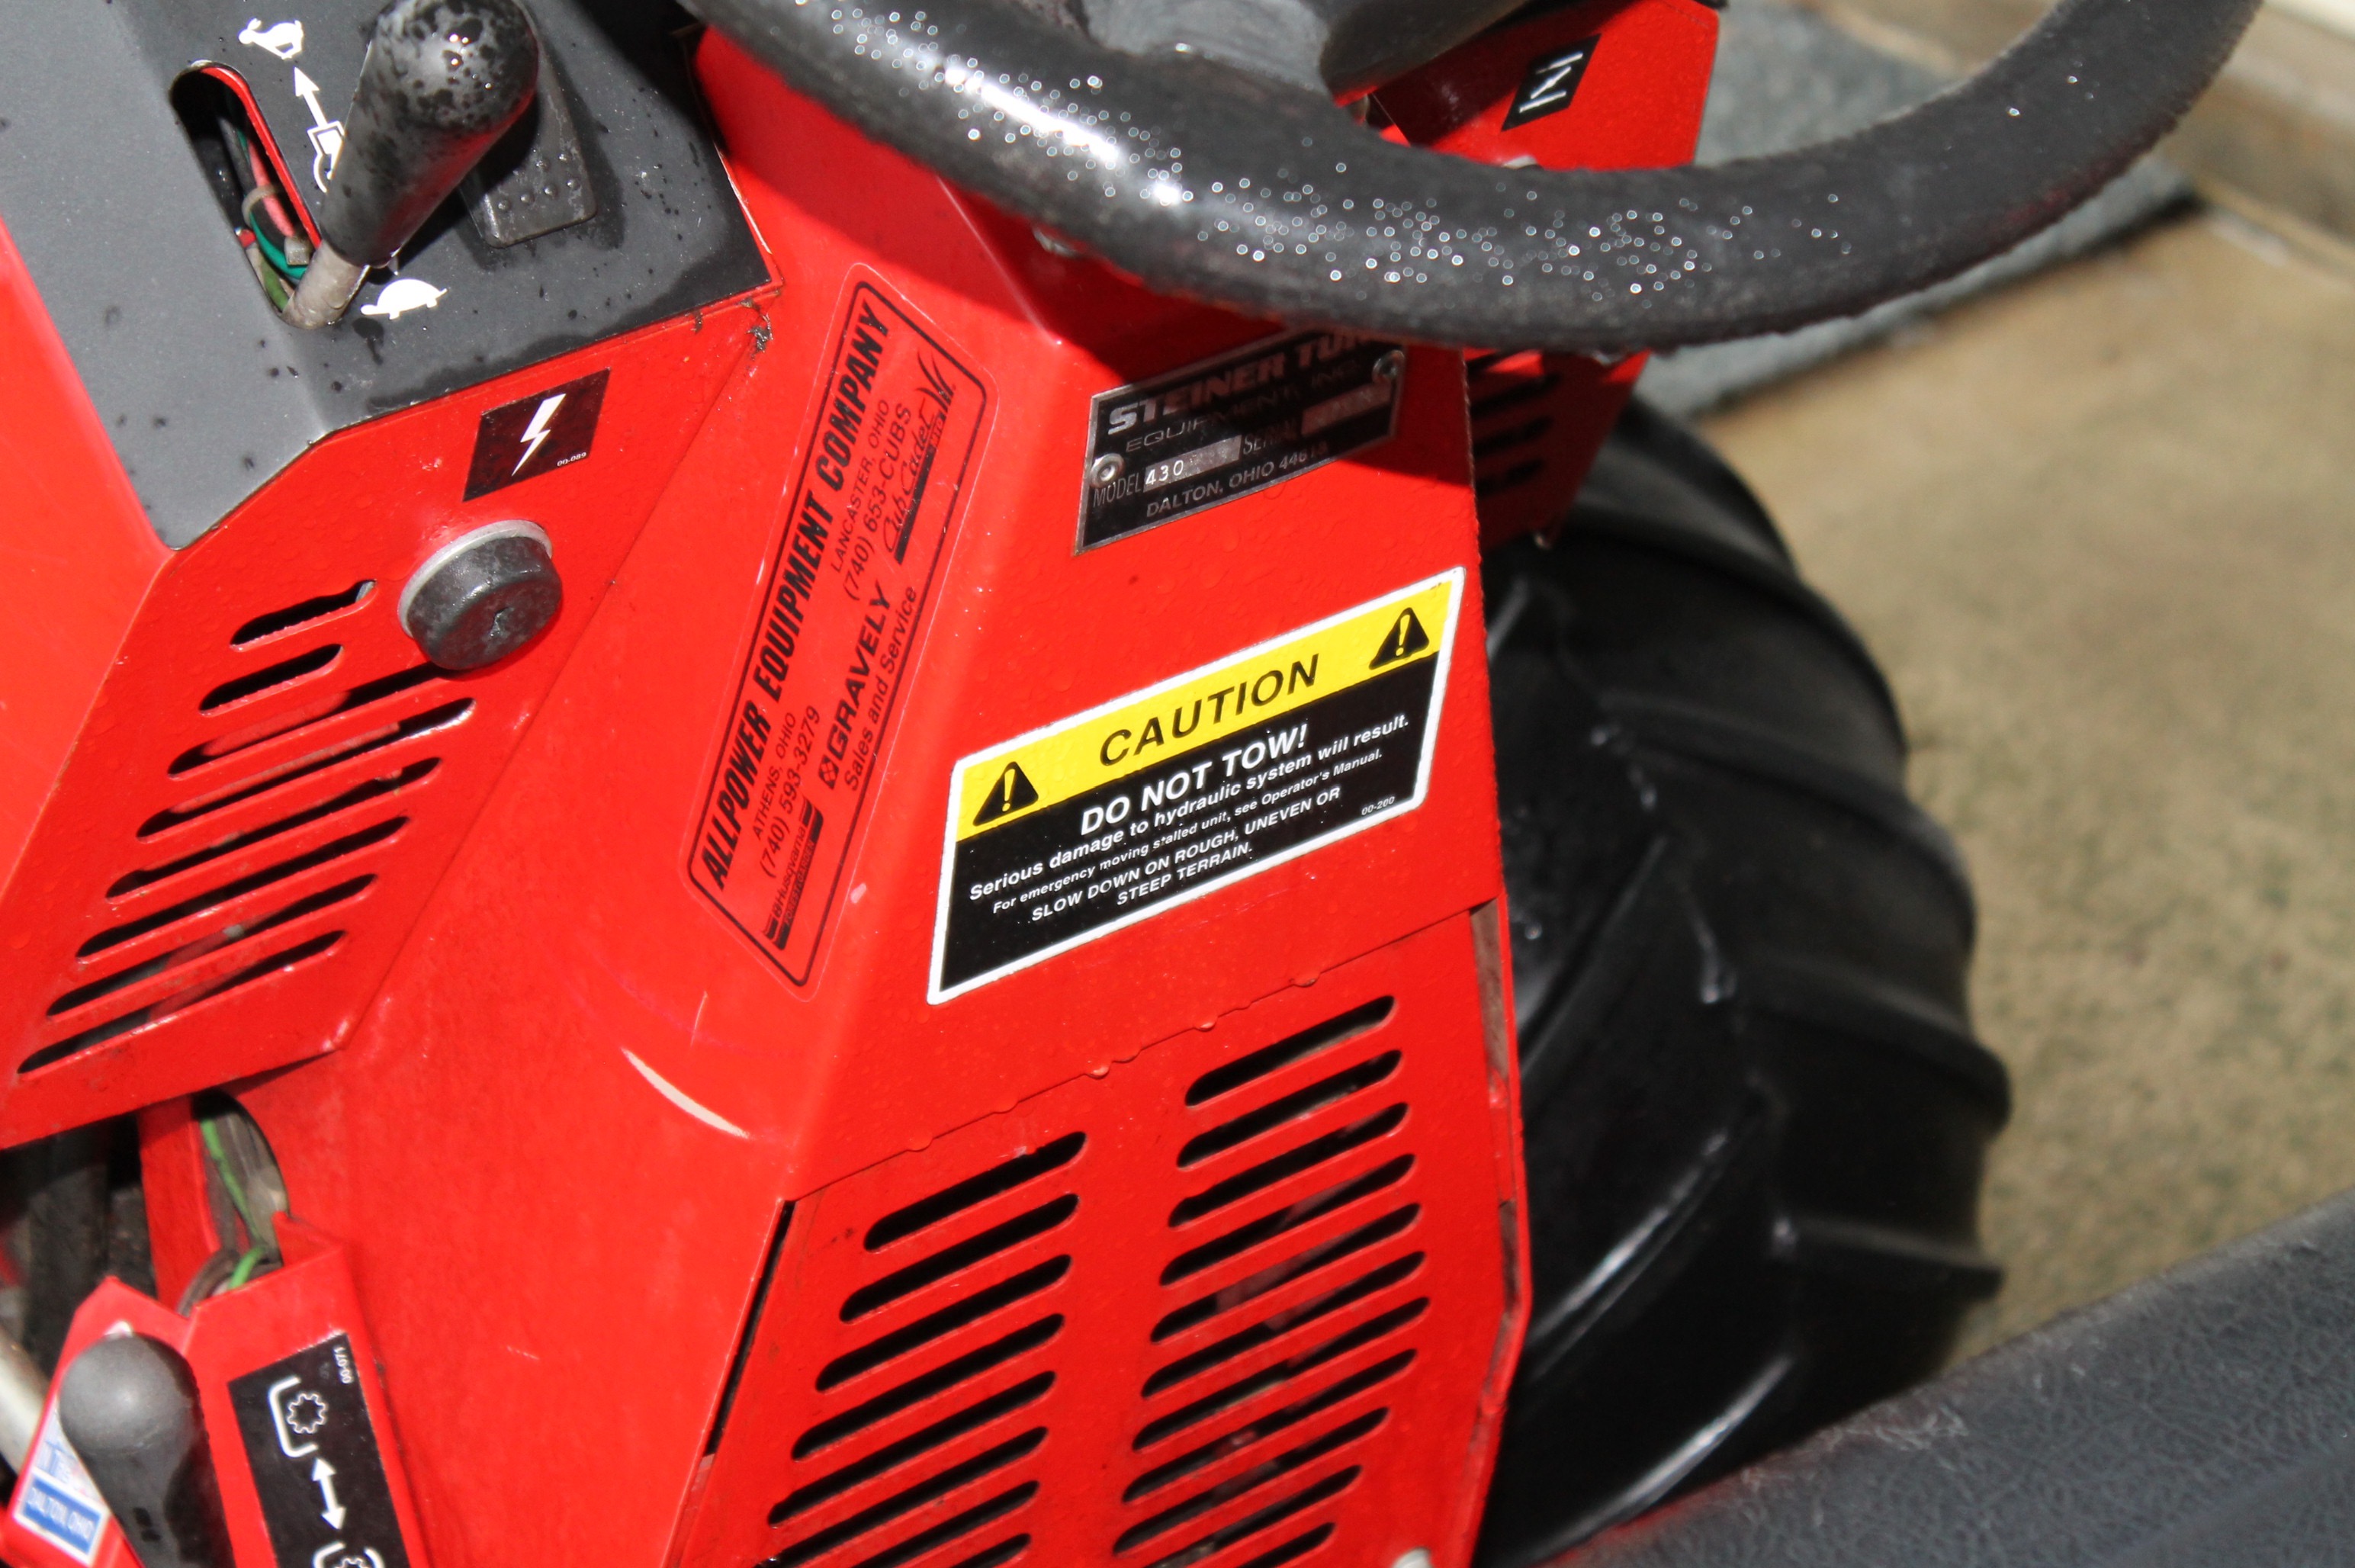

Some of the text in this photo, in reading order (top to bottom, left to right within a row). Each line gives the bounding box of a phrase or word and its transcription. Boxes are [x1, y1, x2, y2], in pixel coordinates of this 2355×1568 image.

[1108, 352, 1286, 435] STEINER
[557, 451, 586, 468] 00-089
[831, 400, 889, 574] LANCASTER, OHIO
[843, 403, 911, 601] (740) 653-CUBS
[883, 494, 907, 553] Cub
[1093, 474, 1142, 509] MODEL
[1145, 460, 1184, 486] 430
[1146, 478, 1223, 518] DALTON,
[1229, 461, 1275, 488] OHIO
[702, 300, 889, 891] ALLPOWER EQUIPMENT COMPANY
[827, 579, 890, 761] GRAVELY
[844, 586, 917, 792] Sales and Service
[1099, 654, 1319, 766] CAUTION
[753, 712, 797, 841] ATHENS, OHIO
[760, 705, 821, 879] (740) 593-3279
[969, 714, 1409, 901] Serious damage to hydraulic system will result.
[993, 749, 1383, 914] For emergency moving stalled unit, see Operator's Manual.
[1081, 724, 1308, 836] DO NOT TOW!
[1361, 796, 1395, 817] 00-200
[1032, 787, 1341, 921] SLOW DOWN ON ROUGH, UNEVEN OR
[1116, 842, 1253, 906] STEEP TERRAIN.
